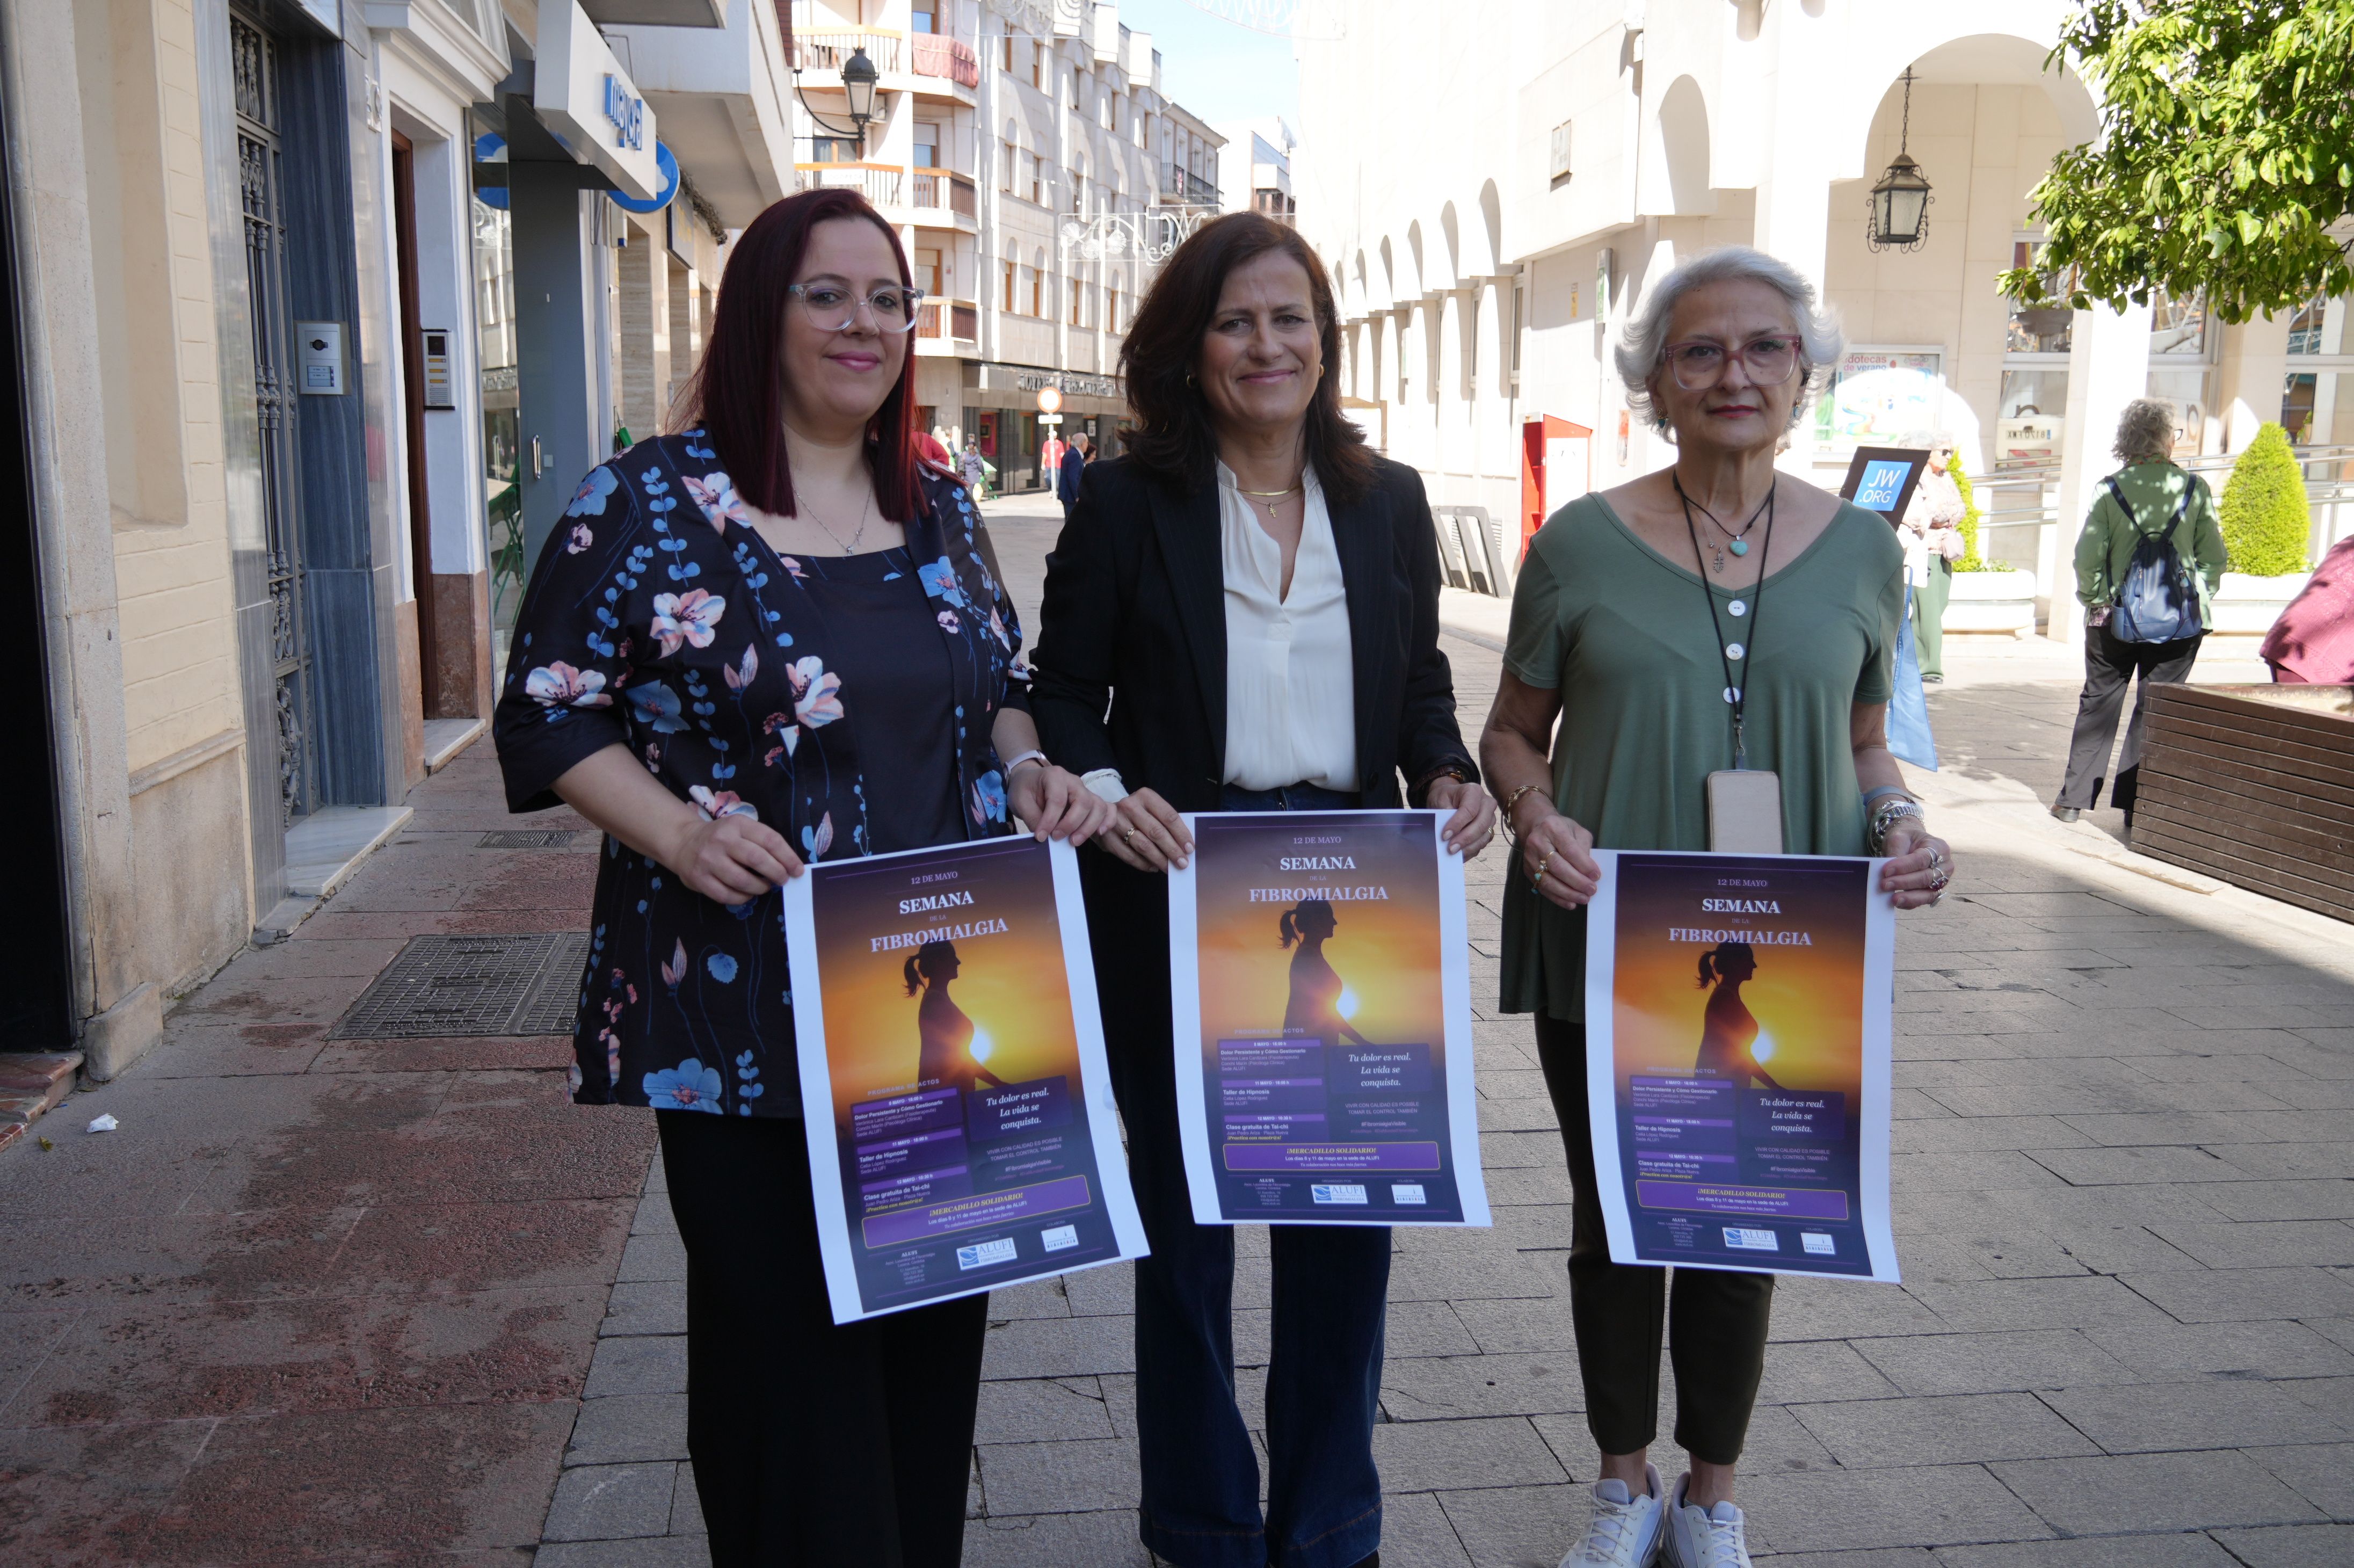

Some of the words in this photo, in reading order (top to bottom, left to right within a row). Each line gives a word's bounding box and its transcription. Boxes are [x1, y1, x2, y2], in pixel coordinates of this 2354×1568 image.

[1843, 355, 1886, 363] dotecas
[1868, 469, 1901, 488] JW
[1859, 490, 1892, 503] .ORG
[1280, 856, 1356, 870] SEMANA
[922, 874, 933, 882] DE
[935, 871, 957, 881] MAYO
[1249, 887, 1388, 902] FIBROMIALGIA
[899, 891, 974, 914] SEMANA
[1702, 898, 1781, 913] SEMANA
[871, 918, 1008, 953] FIBROMIALGIA
[1669, 928, 1812, 945] FIBROMIALGIA
[1361, 1053, 1382, 1061] dolor
[1393, 1052, 1411, 1061] real.
[1373, 1065, 1390, 1073] vida
[867, 1085, 904, 1095] PROGRAMA
[918, 1078, 940, 1086] ACTOS
[1361, 1078, 1400, 1087] conquista.
[986, 1097, 997, 1106] Tu
[998, 1092, 1020, 1104] dolor
[1030, 1087, 1049, 1098] real.
[1760, 1098, 1770, 1106] Tu
[1772, 1098, 1794, 1107] dolor
[1806, 1099, 1825, 1108] real.
[869, 1108, 896, 1117] Persistente
[916, 1099, 942, 1108] Gestionarlo
[999, 1107, 1010, 1117] La
[1012, 1104, 1029, 1114] vida
[1771, 1110, 1782, 1119] La
[1784, 1110, 1802, 1120] vida
[1000, 1115, 1042, 1131] conquista.
[1771, 1123, 1812, 1134] conquista.
[1012, 1142, 1033, 1150] CALIDAD
[1042, 1136, 1062, 1144] POSIBLE
[1016, 1148, 1039, 1156] CONTROL
[1040, 1143, 1061, 1152] TAMBIÉN
[884, 1149, 908, 1158] Hipnosis
[1005, 1158, 1051, 1172] #FibromialgiaVisible
[1771, 1165, 1815, 1174] #FibromialgiaVisible
[864, 1193, 880, 1201] Clase
[881, 1188, 902, 1199] gratuita
[911, 1182, 929, 1191] Tai-chi
[1698, 1188, 1744, 1196] ¡MERCADILLO
[1745, 1190, 1785, 1199] SOLIDARIO!
[929, 1201, 979, 1216] ¡MERCADILLO
[980, 1192, 1023, 1206] SOLIDARIO!
[1742, 1230, 1774, 1239] ALUFI
[978, 1239, 1012, 1254] ALUFI
